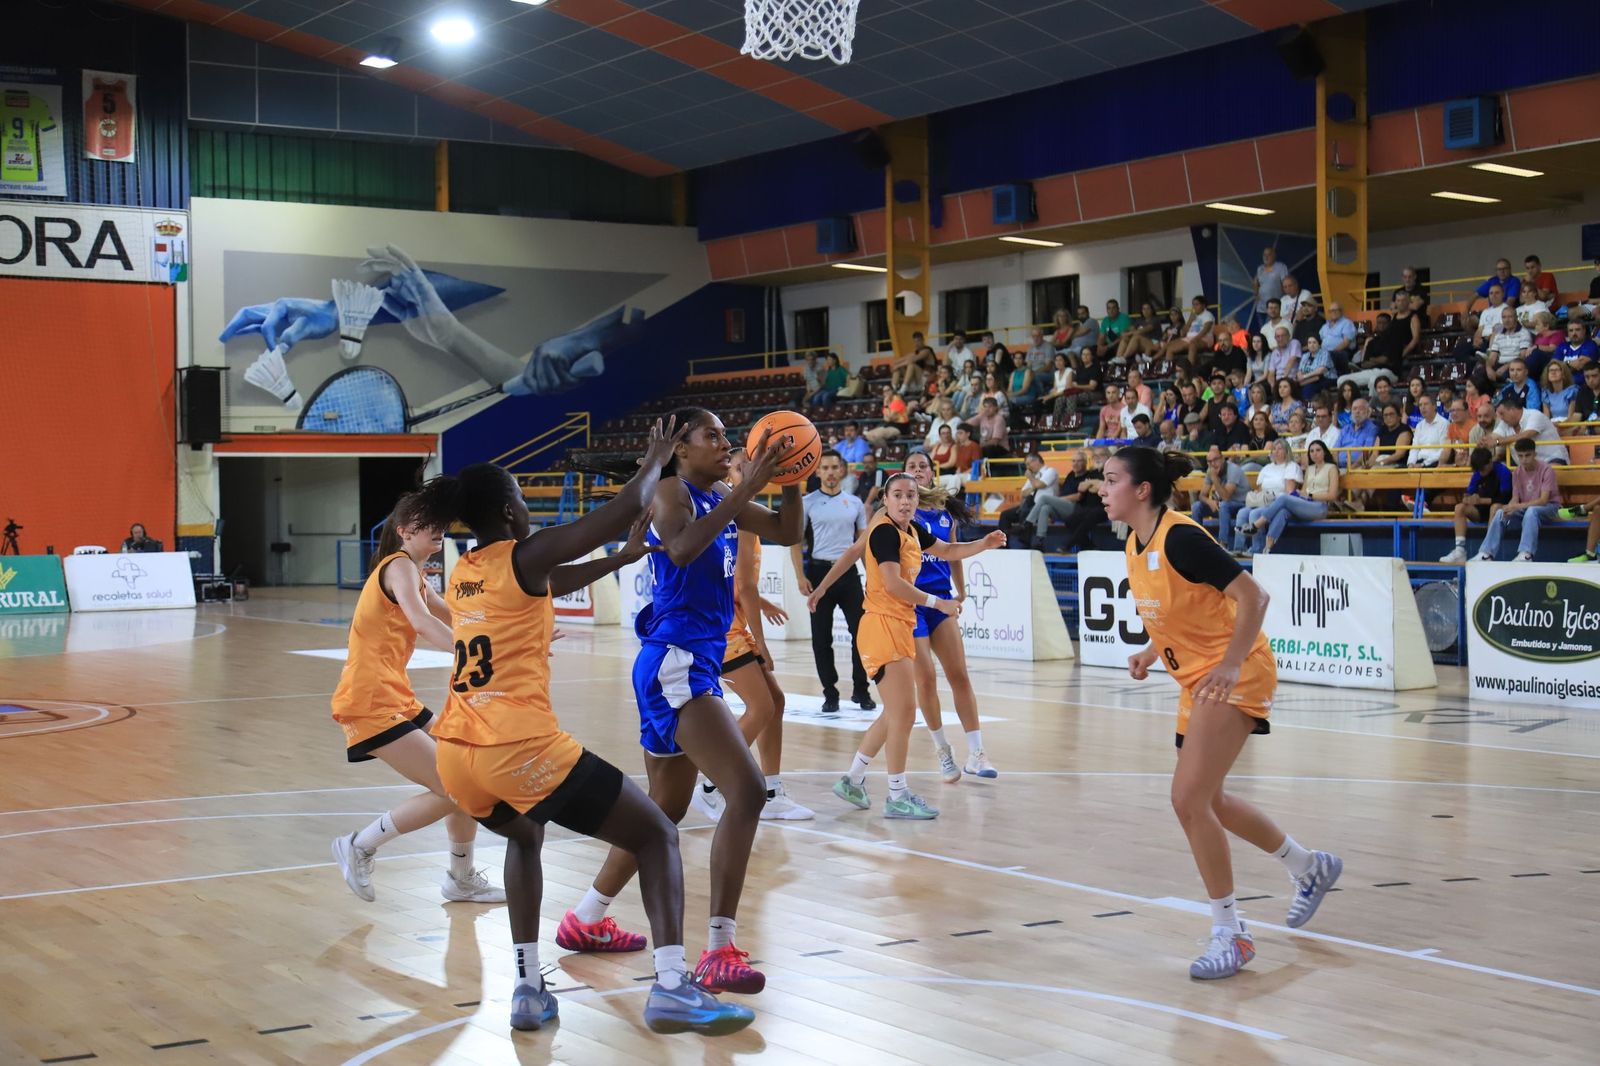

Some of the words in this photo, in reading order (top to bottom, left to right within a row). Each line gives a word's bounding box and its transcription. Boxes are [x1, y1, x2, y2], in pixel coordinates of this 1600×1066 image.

[12, 117, 24, 139] 9
[0, 214, 134, 271] ORA
[92, 591, 142, 602] recoletas
[146, 590, 172, 600] salud
[1488, 596, 1553, 633] Paulino
[994, 624, 1024, 641] salud
[1084, 634, 1115, 644] GIMNASIO
[1267, 637, 1351, 661] ERBI-PLAST,
[1358, 645, 1382, 661] S.L.
[1511, 638, 1550, 649] Embutidos
[1552, 642, 1557, 651] y
[1558, 641, 1592, 652] Jamones
[453, 635, 494, 692] 23
[1164, 647, 1179, 671] 8
